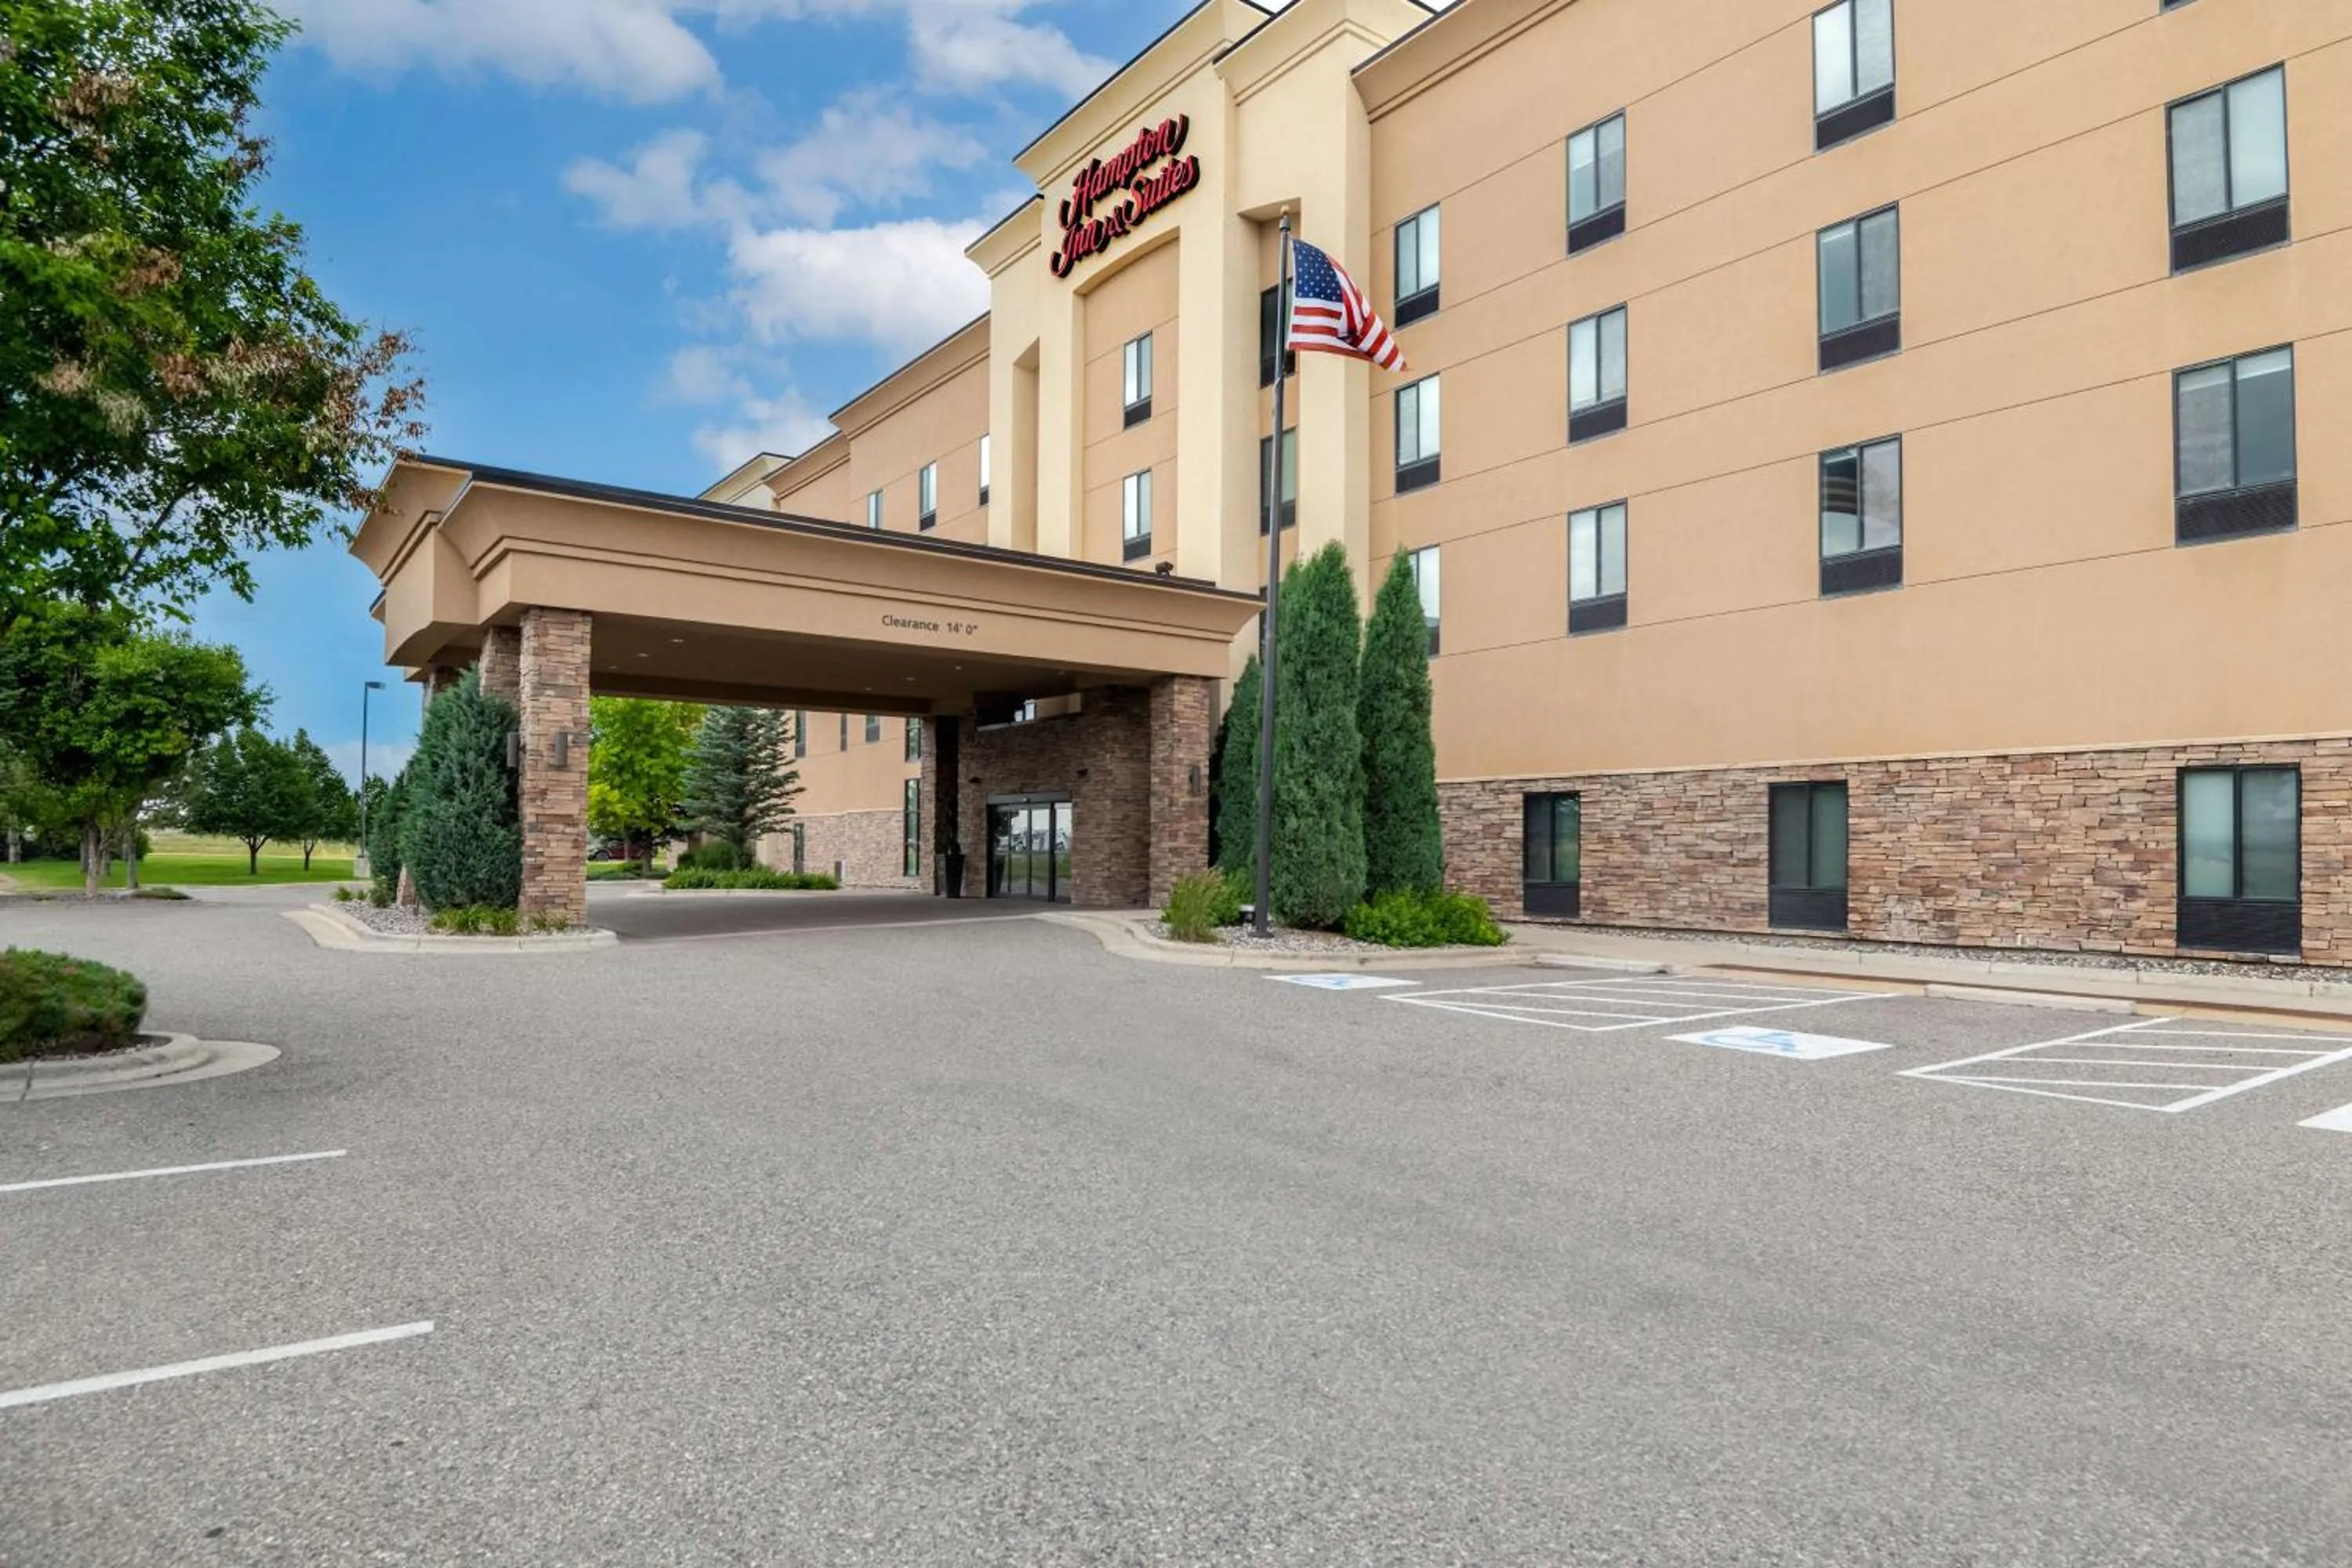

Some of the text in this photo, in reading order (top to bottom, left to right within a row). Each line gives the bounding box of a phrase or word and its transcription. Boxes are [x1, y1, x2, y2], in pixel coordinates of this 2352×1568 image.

[1050, 217, 1112, 278] Inn
[1122, 154, 1200, 227] Suites
[1058, 114, 1189, 231] Hampton
